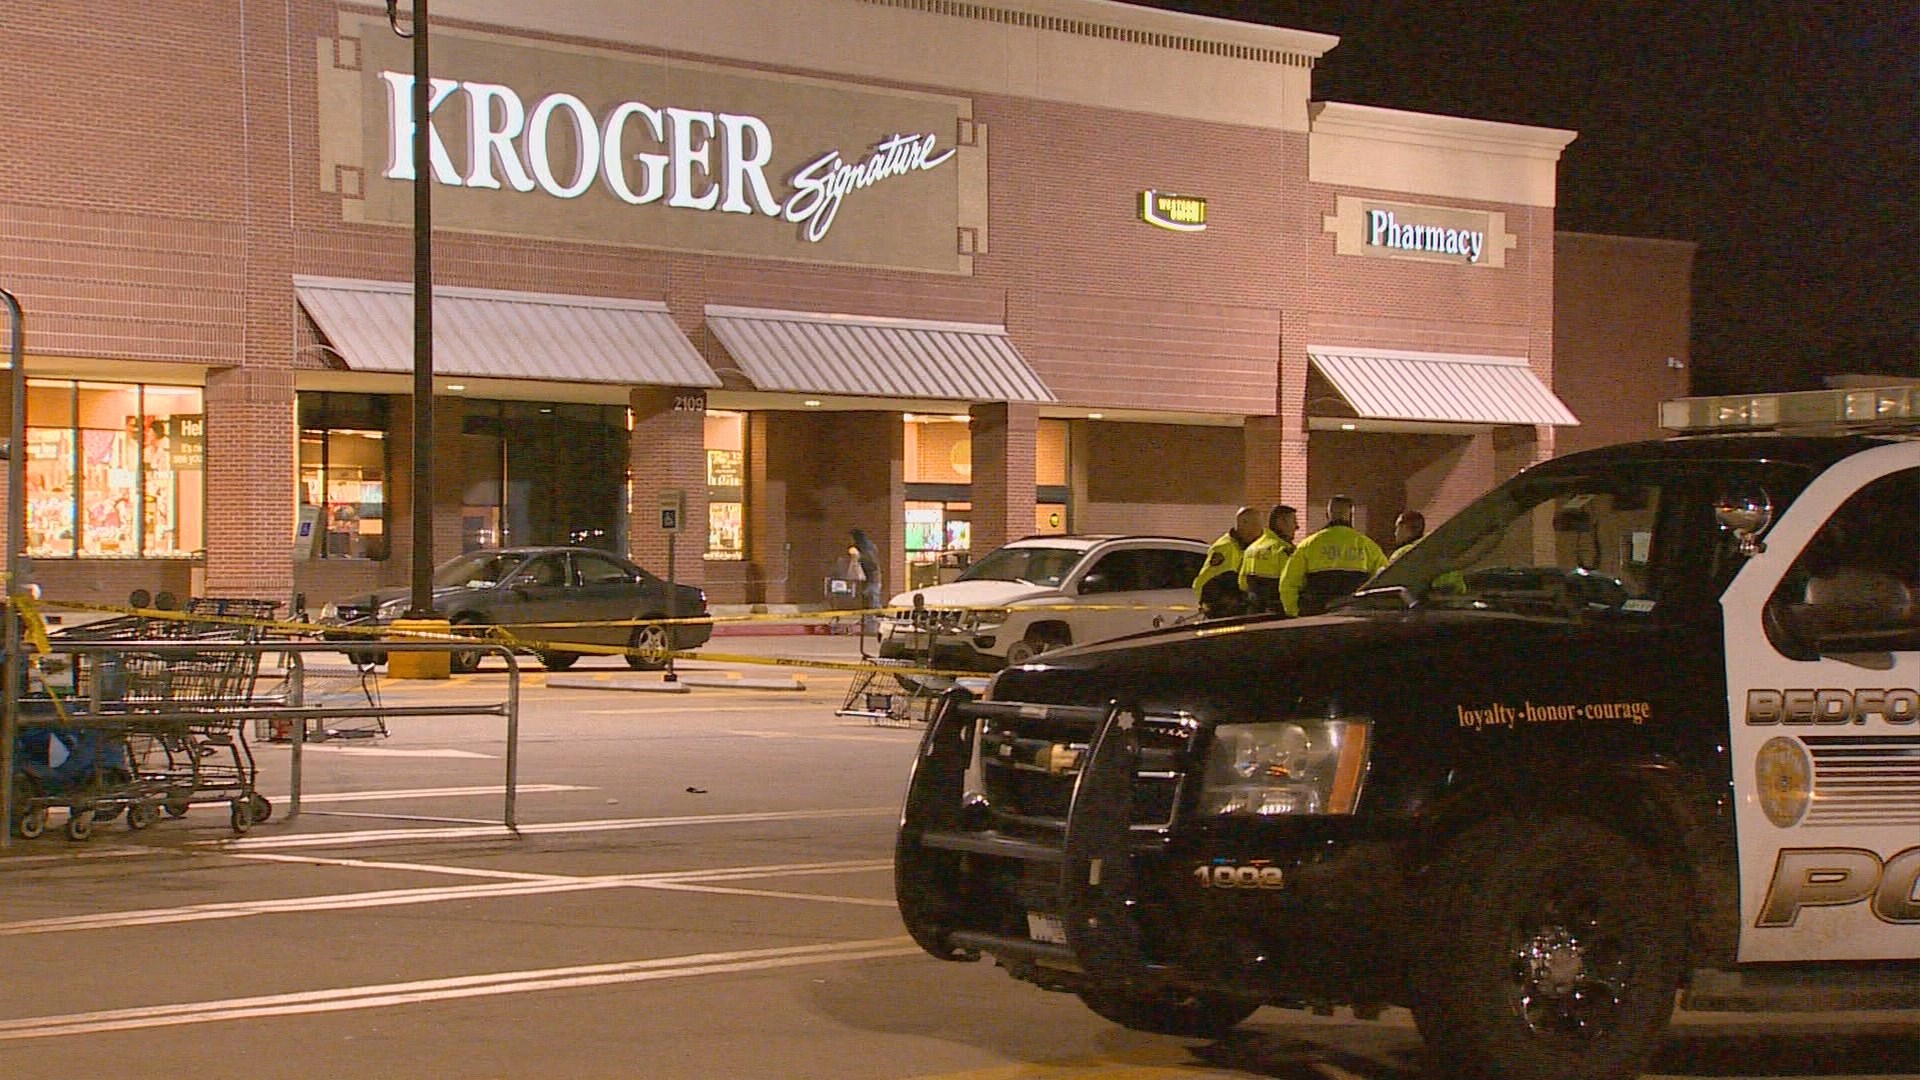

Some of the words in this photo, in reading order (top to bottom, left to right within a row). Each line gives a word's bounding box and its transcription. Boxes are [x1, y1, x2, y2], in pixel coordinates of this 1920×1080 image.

[381, 70, 782, 217] KROGER
[784, 132, 956, 243] Signature
[1369, 208, 1485, 263] Pharmacy
[673, 395, 704, 412] 2109
[1745, 688, 1920, 726] BEDFO
